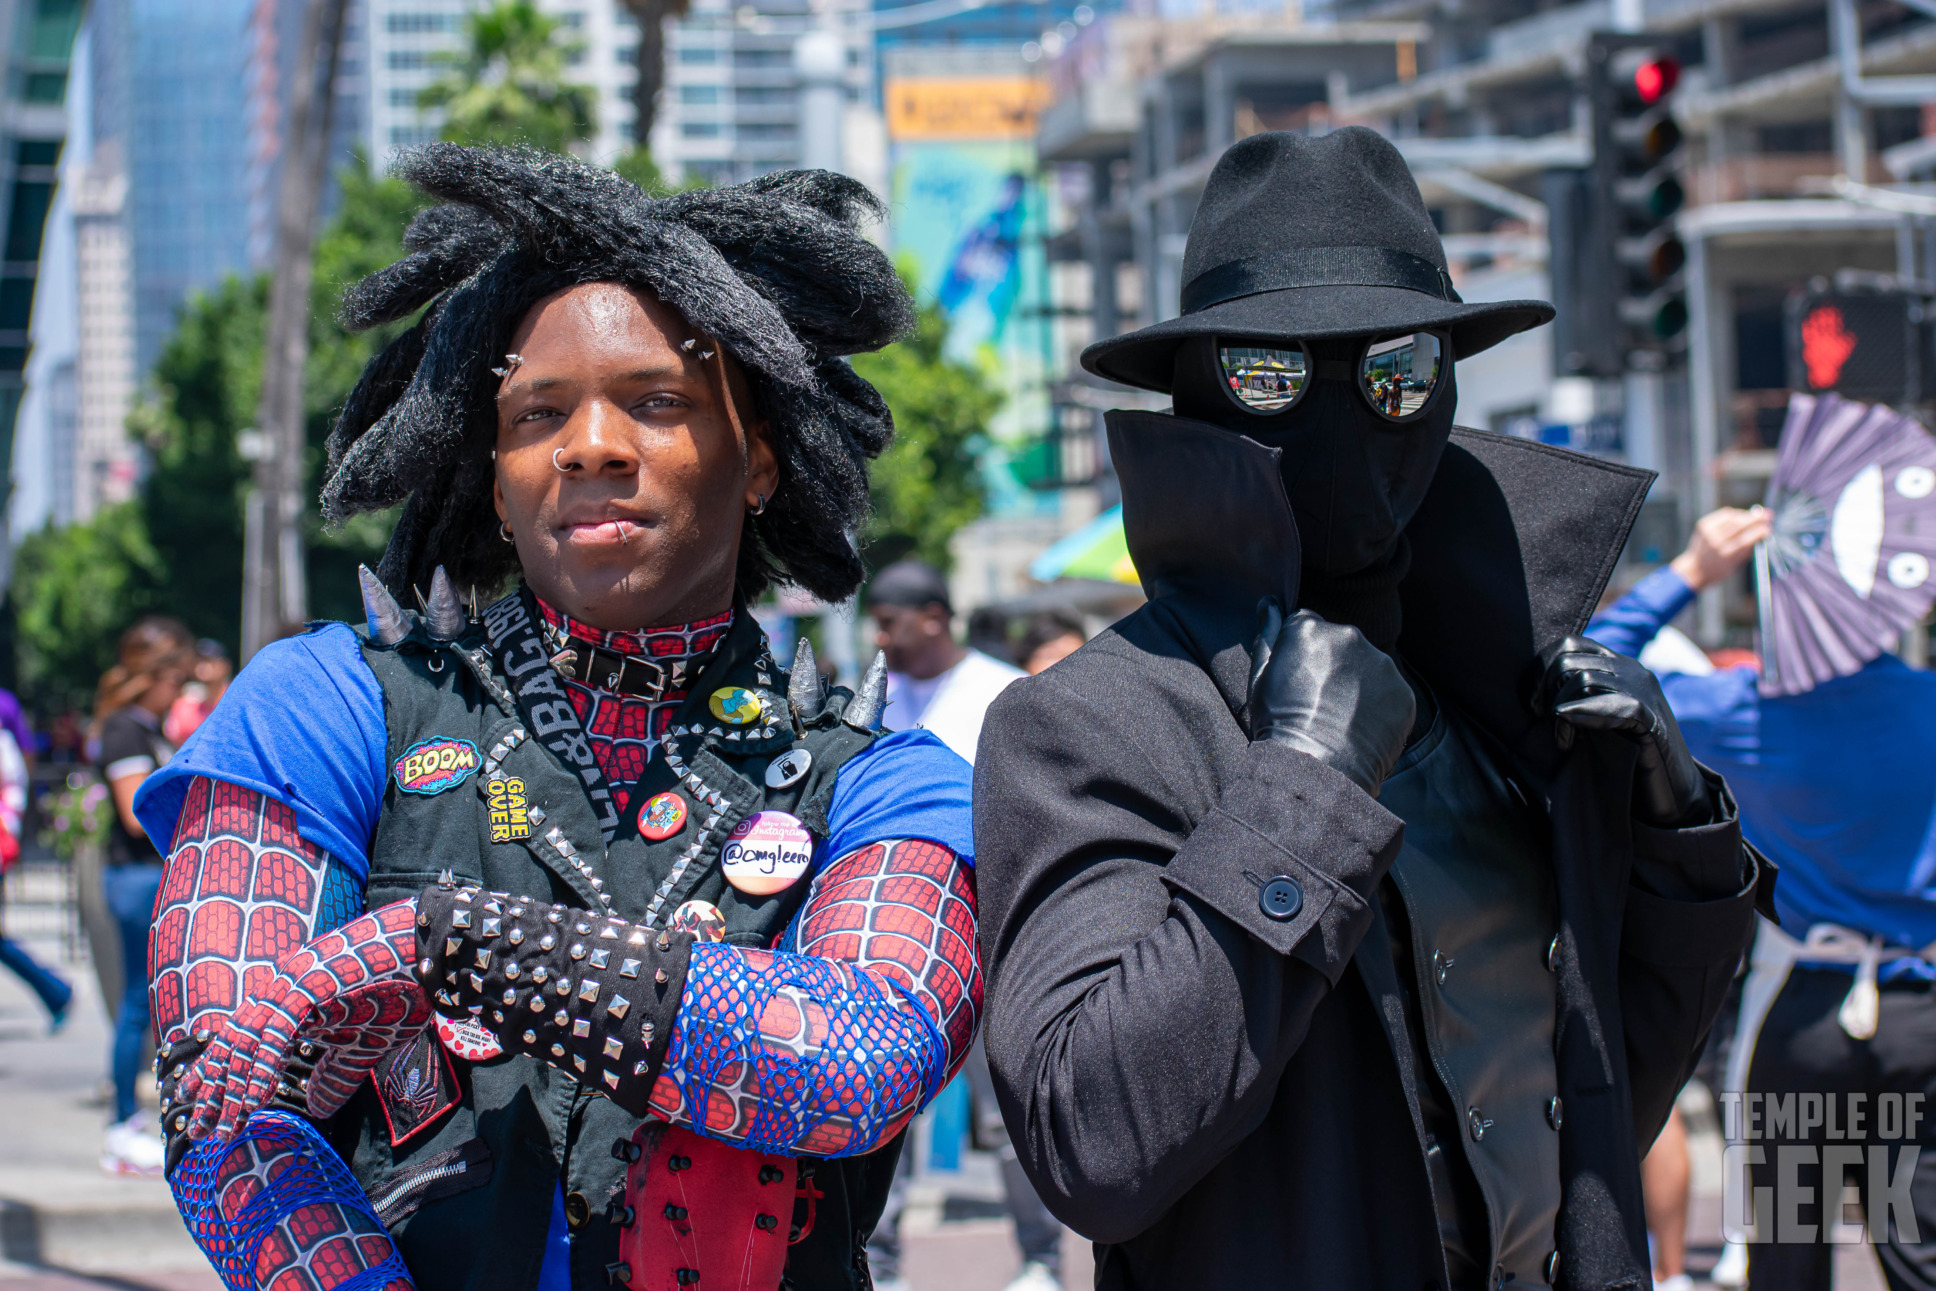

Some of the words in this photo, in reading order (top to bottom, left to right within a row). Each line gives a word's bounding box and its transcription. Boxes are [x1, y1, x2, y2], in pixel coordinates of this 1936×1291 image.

[404, 747, 474, 785] BOOM
[488, 781, 510, 839] OVER
[507, 779, 528, 836] GAME
[750, 823, 807, 840] Instagram
